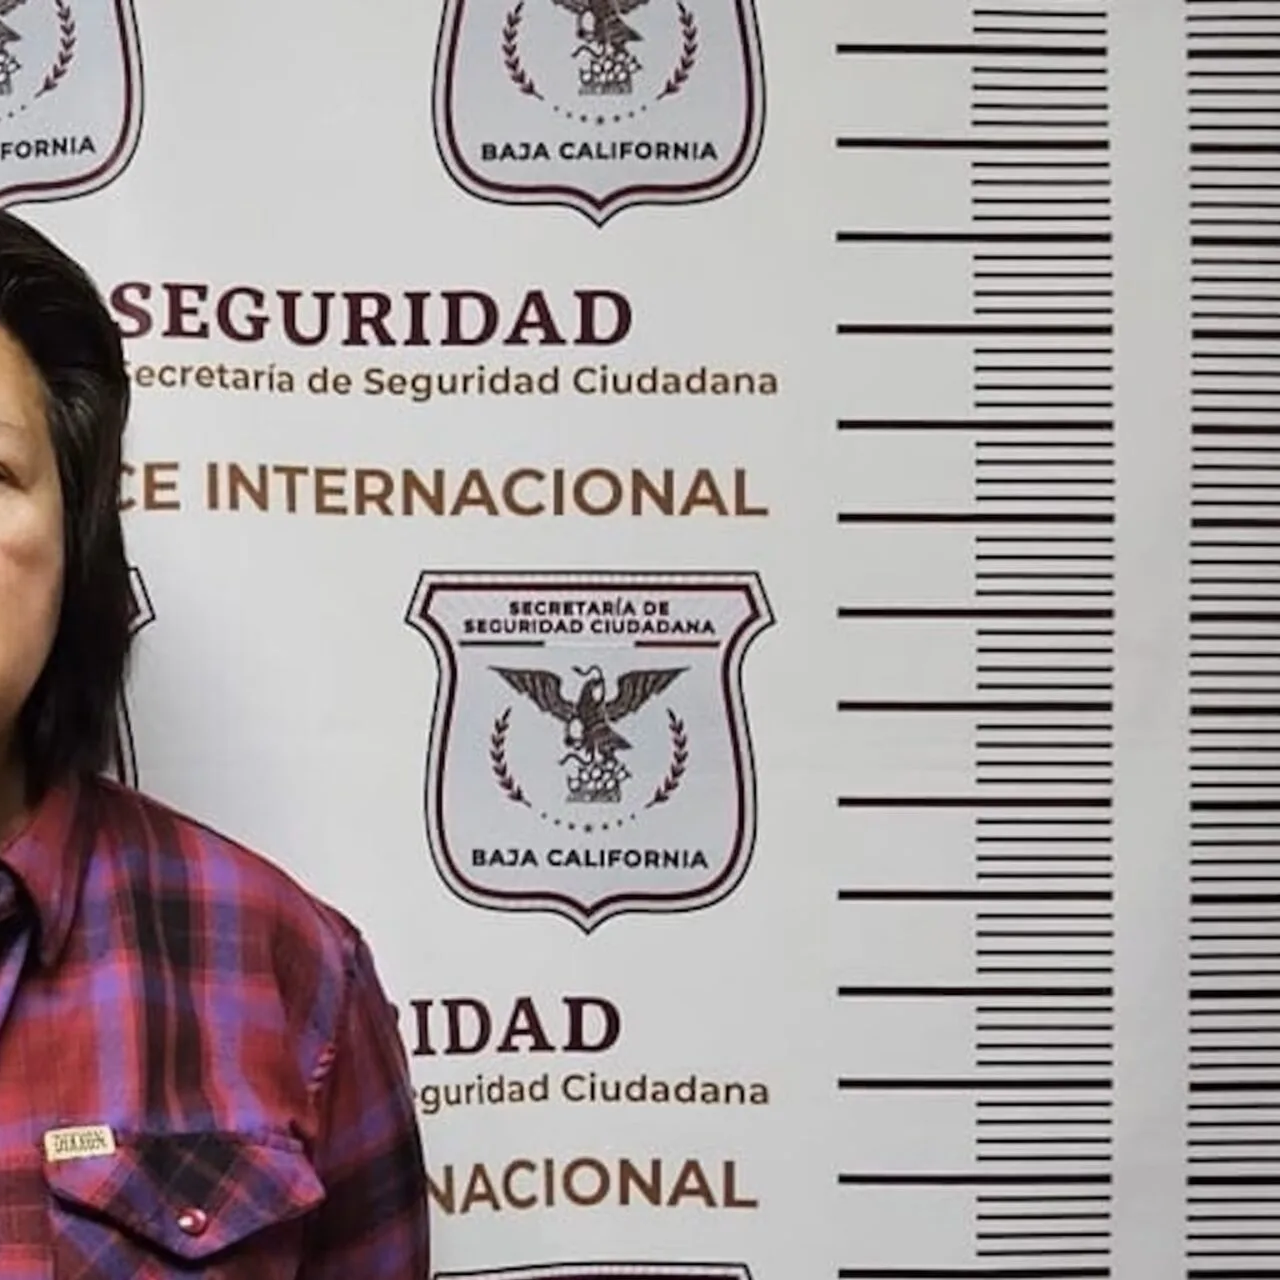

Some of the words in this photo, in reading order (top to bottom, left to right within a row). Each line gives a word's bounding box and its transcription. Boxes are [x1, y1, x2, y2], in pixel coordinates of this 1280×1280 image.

[481, 141, 551, 162] BAJA
[558, 141, 718, 161] CALIFORNIA
[108, 281, 634, 347] SEGURIDAD
[307, 365, 353, 396] de
[364, 364, 560, 403] Seguridad
[572, 364, 778, 396] Ciudadana
[207, 462, 770, 517] INTERNACIONAL
[509, 596, 637, 617] SECRETARÍA
[643, 600, 670, 617] DE
[463, 618, 584, 634] SEGURIDAD
[590, 618, 716, 635] CIUDADANA
[471, 848, 539, 867] BAJA
[546, 848, 709, 869] CALIFORNIA
[395, 996, 621, 1058] IDAD
[413, 1070, 551, 1115] guridad
[561, 1071, 769, 1105] Ciudadana
